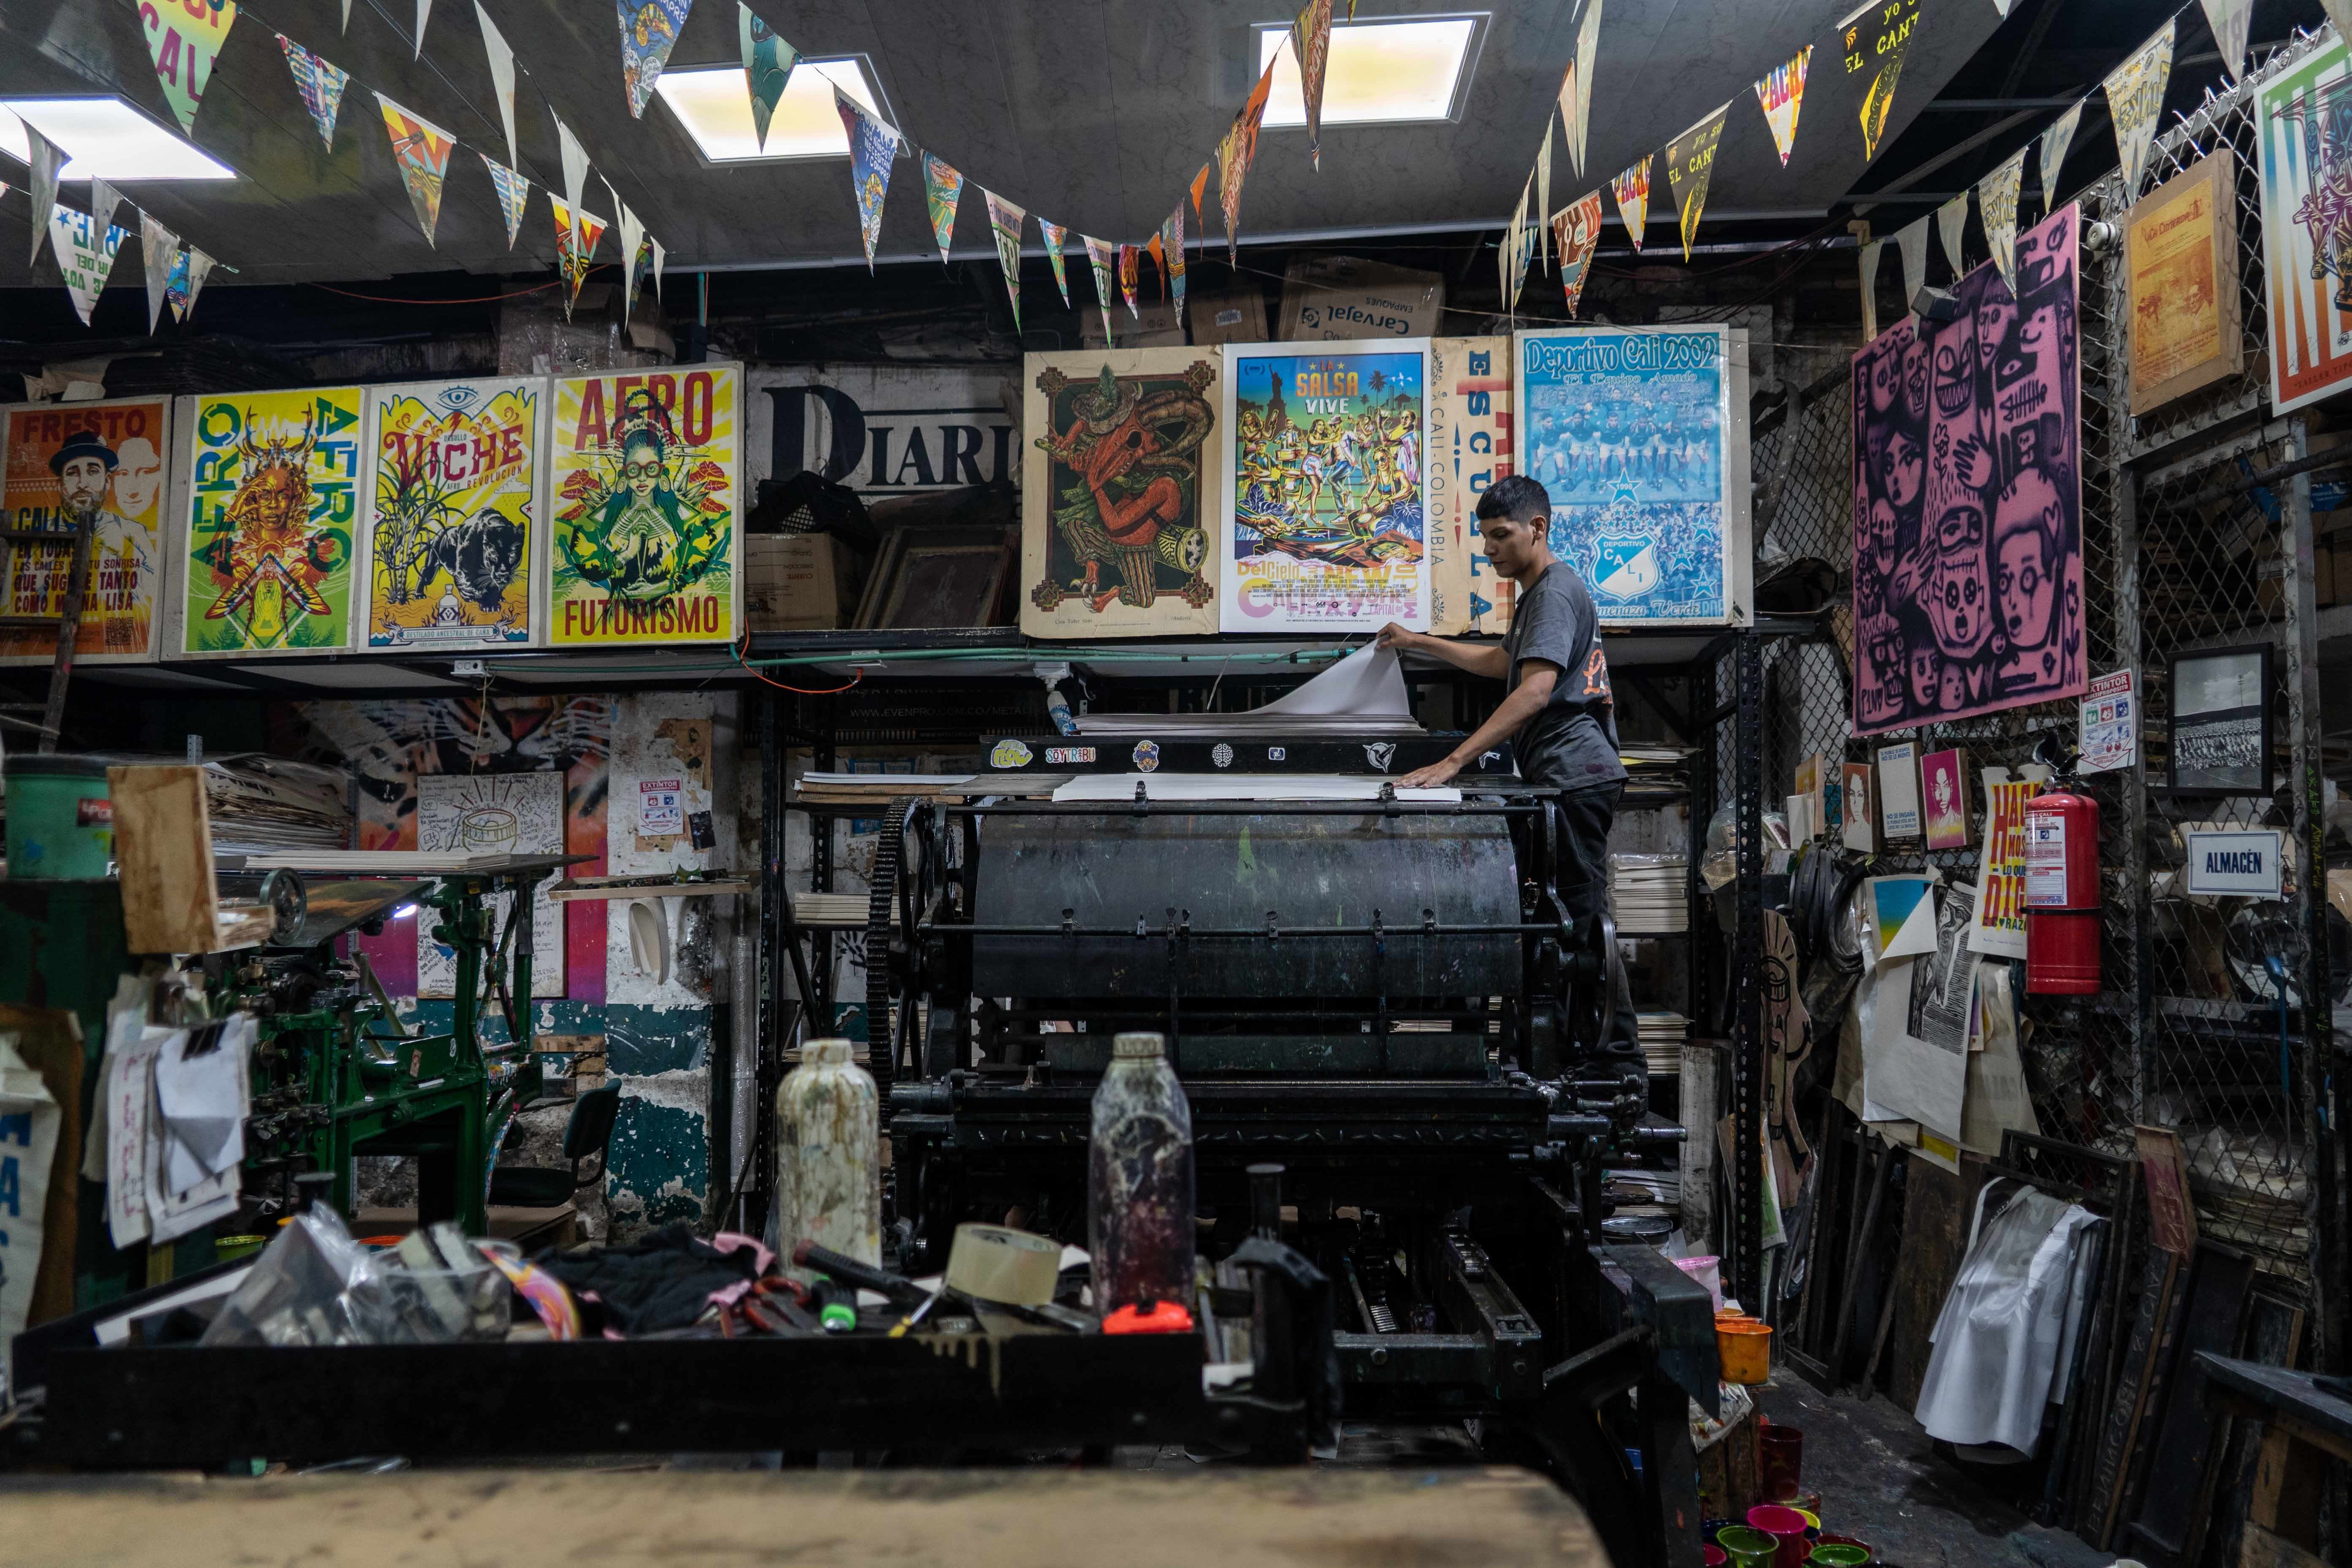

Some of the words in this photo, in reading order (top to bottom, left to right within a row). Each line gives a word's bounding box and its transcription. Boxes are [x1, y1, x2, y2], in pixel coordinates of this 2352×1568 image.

[1365, 296, 1414, 314] EMPAQUES
[1326, 305, 1410, 335] Carvajal
[1320, 361, 1334, 372] LA
[1525, 337, 1617, 378] Deportivo
[1622, 335, 1662, 370] Cali
[1664, 335, 1717, 370] 2002
[1296, 372, 1359, 398] SALSA
[1563, 374, 1583, 385] El
[1590, 373, 1641, 385] Equipo
[1650, 372, 1698, 384] Amado
[575, 371, 714, 451] AFRO
[1305, 398, 1349, 415] VIVE
[23, 409, 147, 443] FRESTO
[761, 385, 1023, 486] DIARI
[443, 434, 467, 443] ORGULLO
[383, 423, 524, 503] VICHE
[446, 482, 461, 490] AFRO
[18, 506, 60, 532] CALI
[39, 540, 75, 559] TODA
[104, 557, 140, 569] SONRISA
[14, 574, 37, 592] QUE
[44, 573, 92, 591] SUGE
[99, 571, 138, 590] TANTO
[14, 595, 48, 614] COMO
[105, 593, 133, 611] LISA
[1370, 603, 1395, 616] CAPITAL
[1592, 603, 1646, 617] menaza
[1652, 601, 1700, 616] Verde
[565, 595, 719, 636] FUTURISMO
[2089, 676, 2128, 693] XTINTOR
[2002, 865, 2012, 876] LO
[2206, 849, 2262, 874] ALMACÉN
[1983, 874, 2026, 927] DIG
